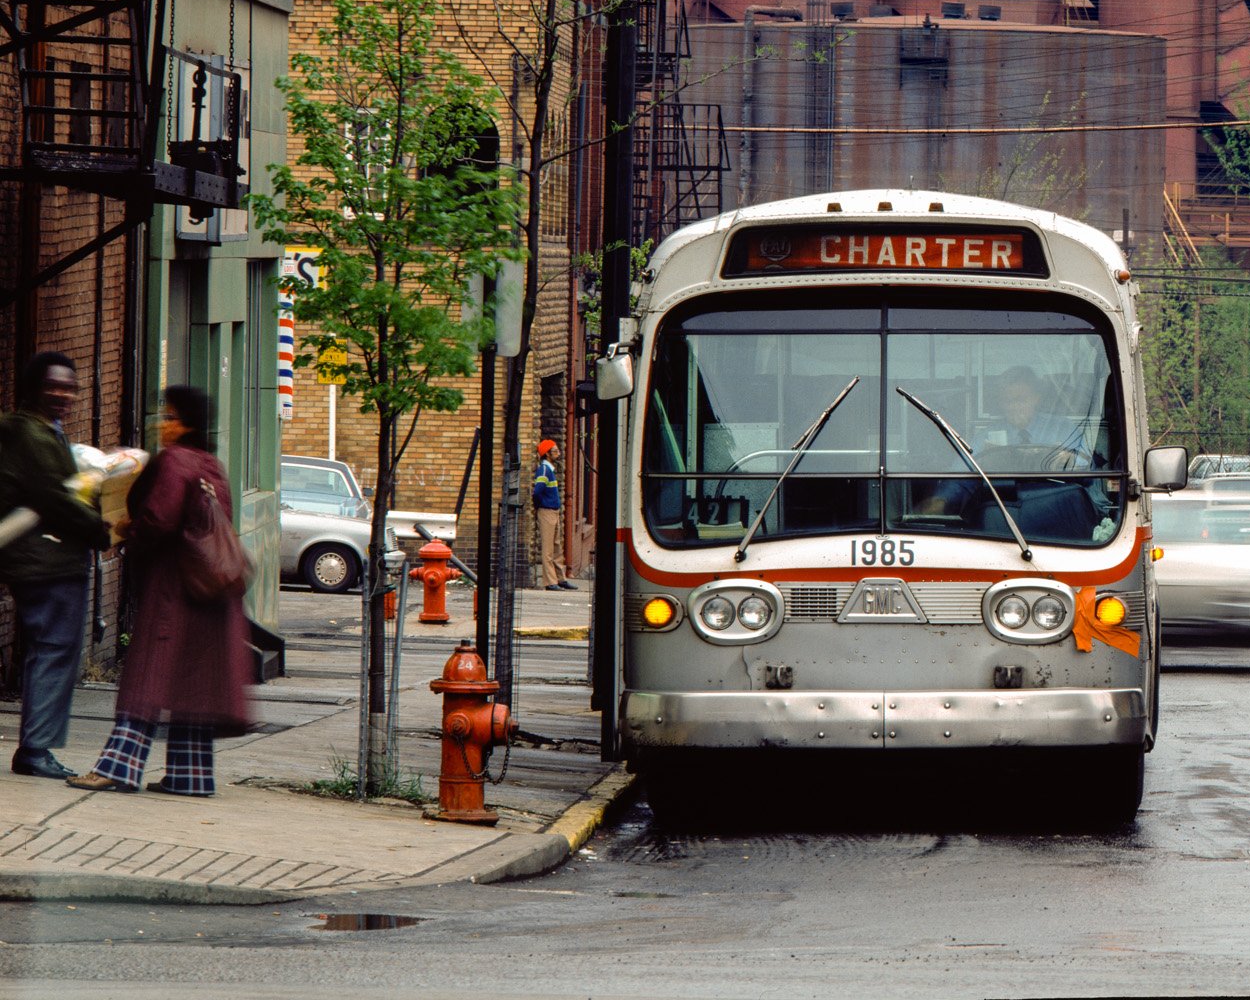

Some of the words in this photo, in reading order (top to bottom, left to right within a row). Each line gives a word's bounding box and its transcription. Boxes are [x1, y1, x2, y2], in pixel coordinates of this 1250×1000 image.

[820, 235, 1012, 268] CHARTER
[851, 540, 915, 566] 1985
[863, 586, 901, 614] GMC
[458, 660, 473, 670] 24
